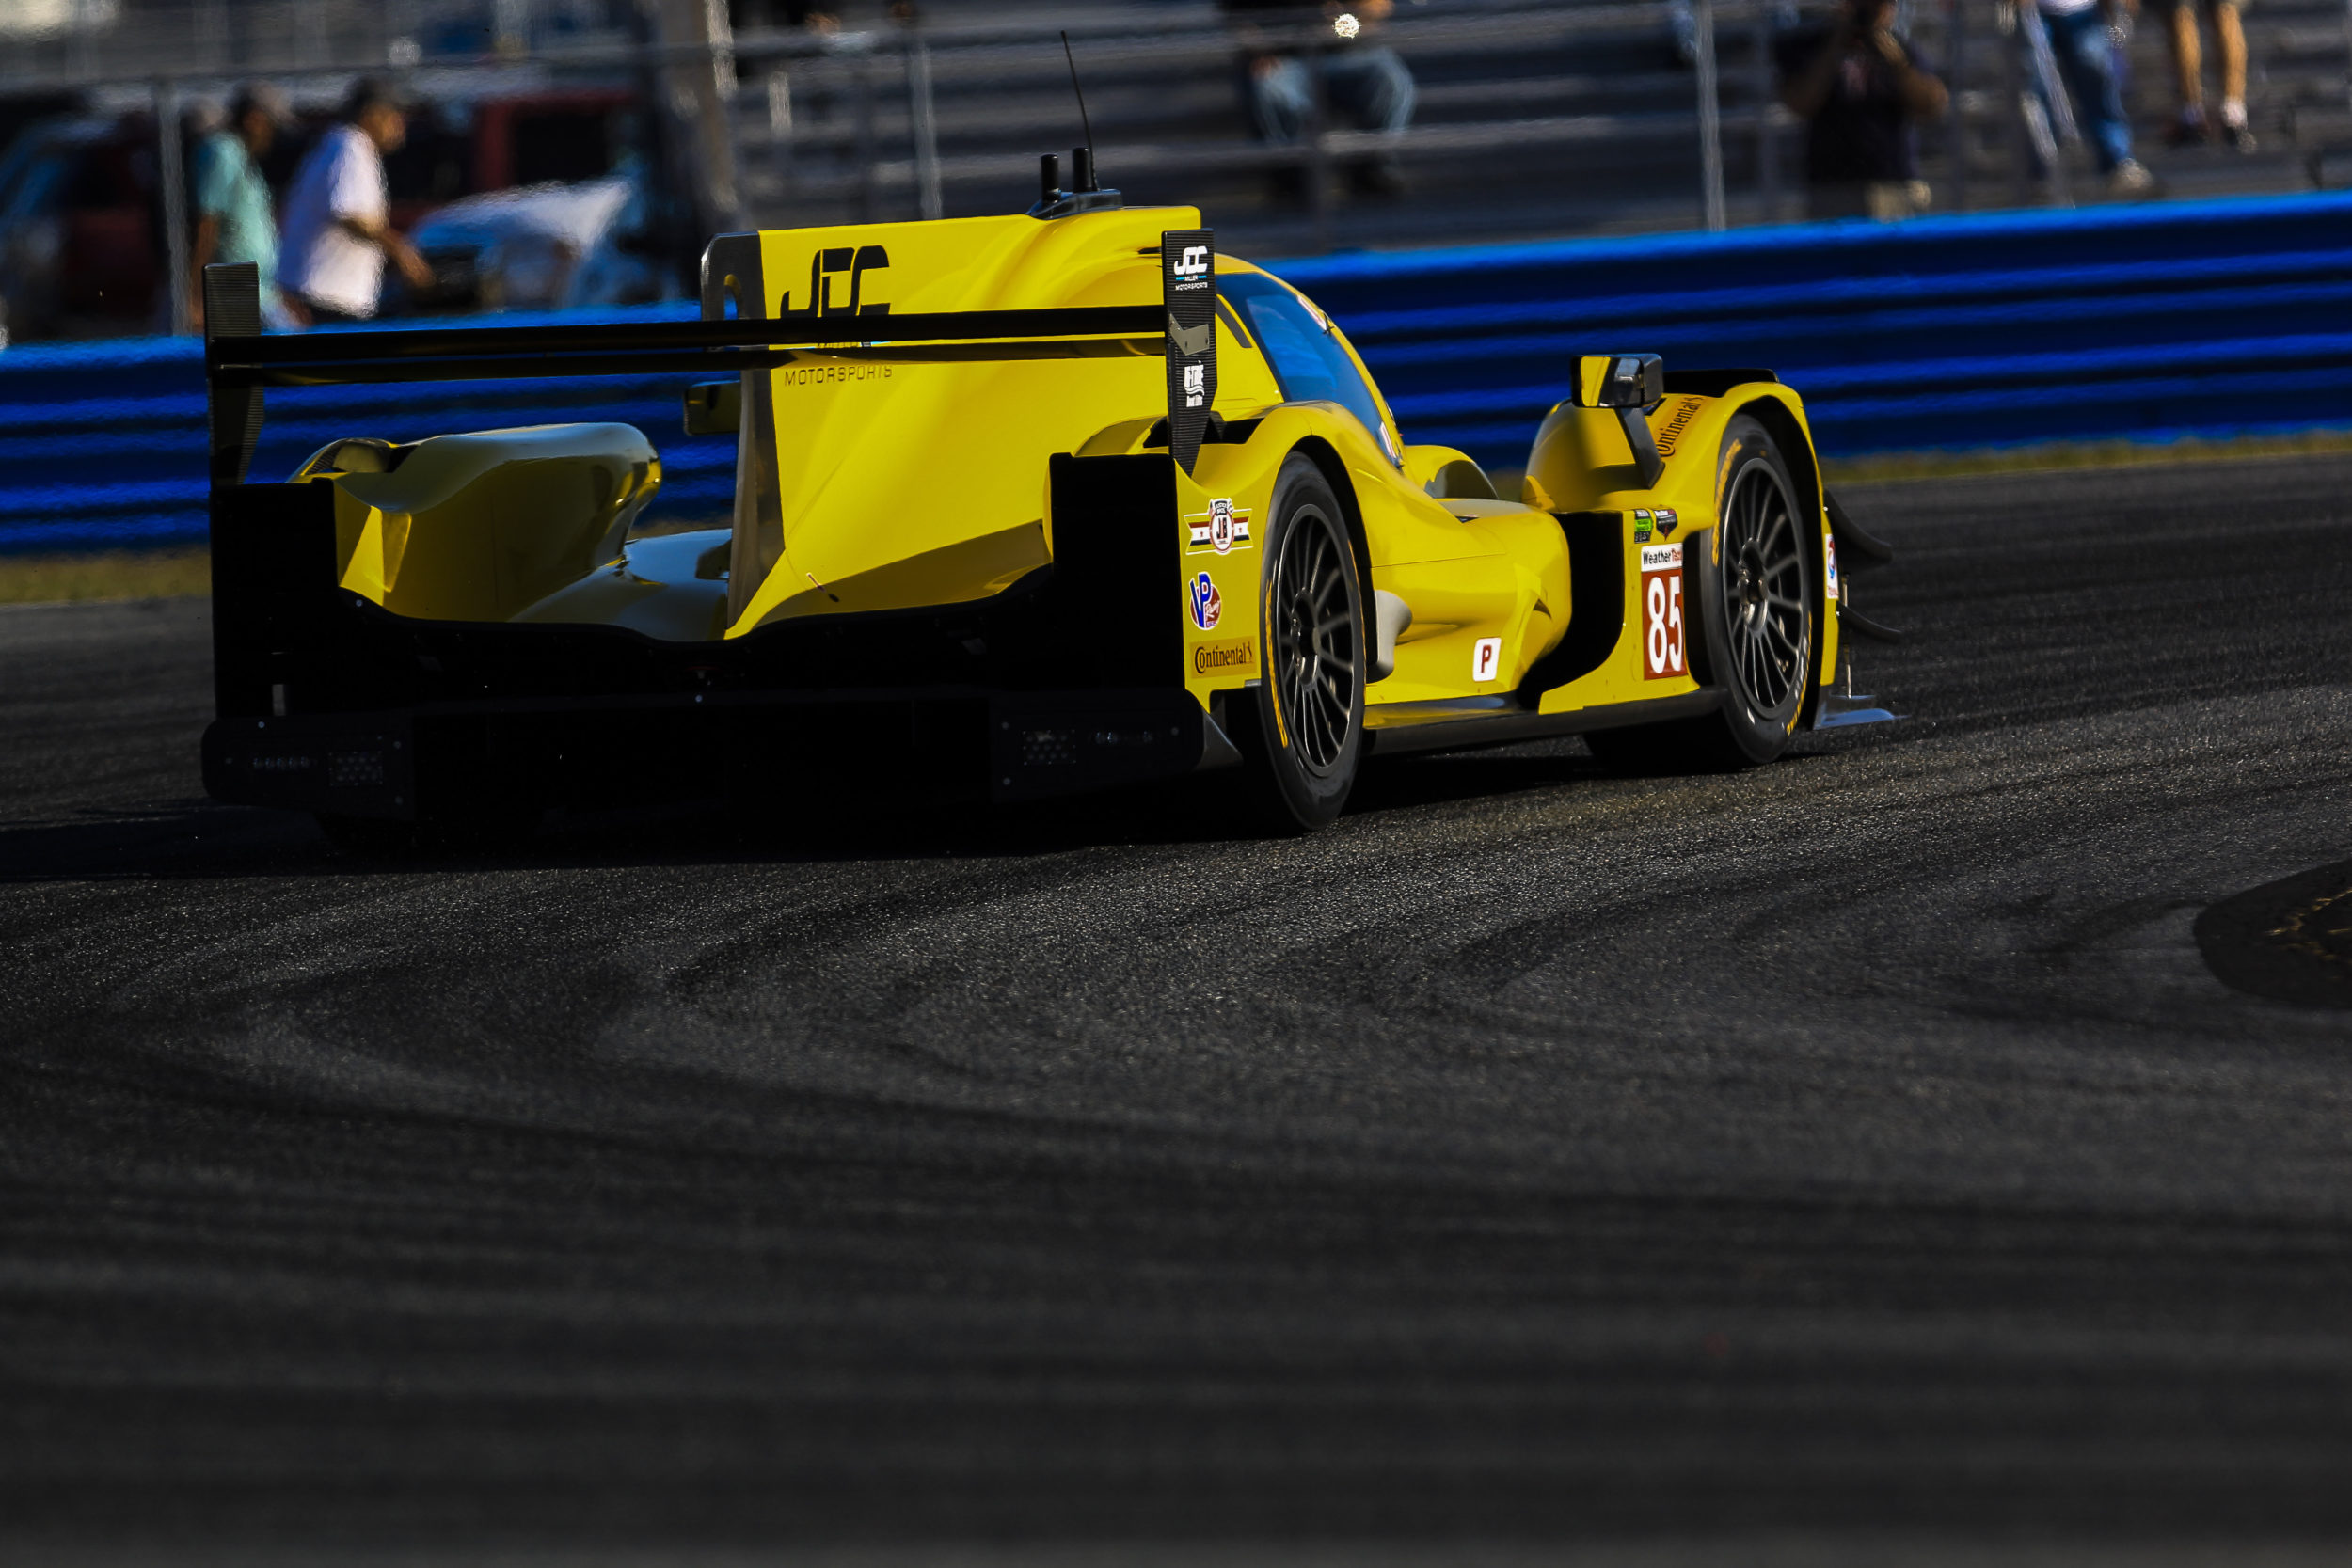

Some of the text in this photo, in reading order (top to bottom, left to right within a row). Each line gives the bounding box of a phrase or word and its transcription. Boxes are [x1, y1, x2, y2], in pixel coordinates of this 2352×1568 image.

[1175, 282, 1208, 291] MOTORSPORTS
[784, 365, 893, 387] MOTORSPORTS
[1189, 573, 1212, 628] VP
[1647, 576, 1683, 674] 85
[1194, 644, 1247, 674] Continental
[1480, 644, 1492, 673] P
